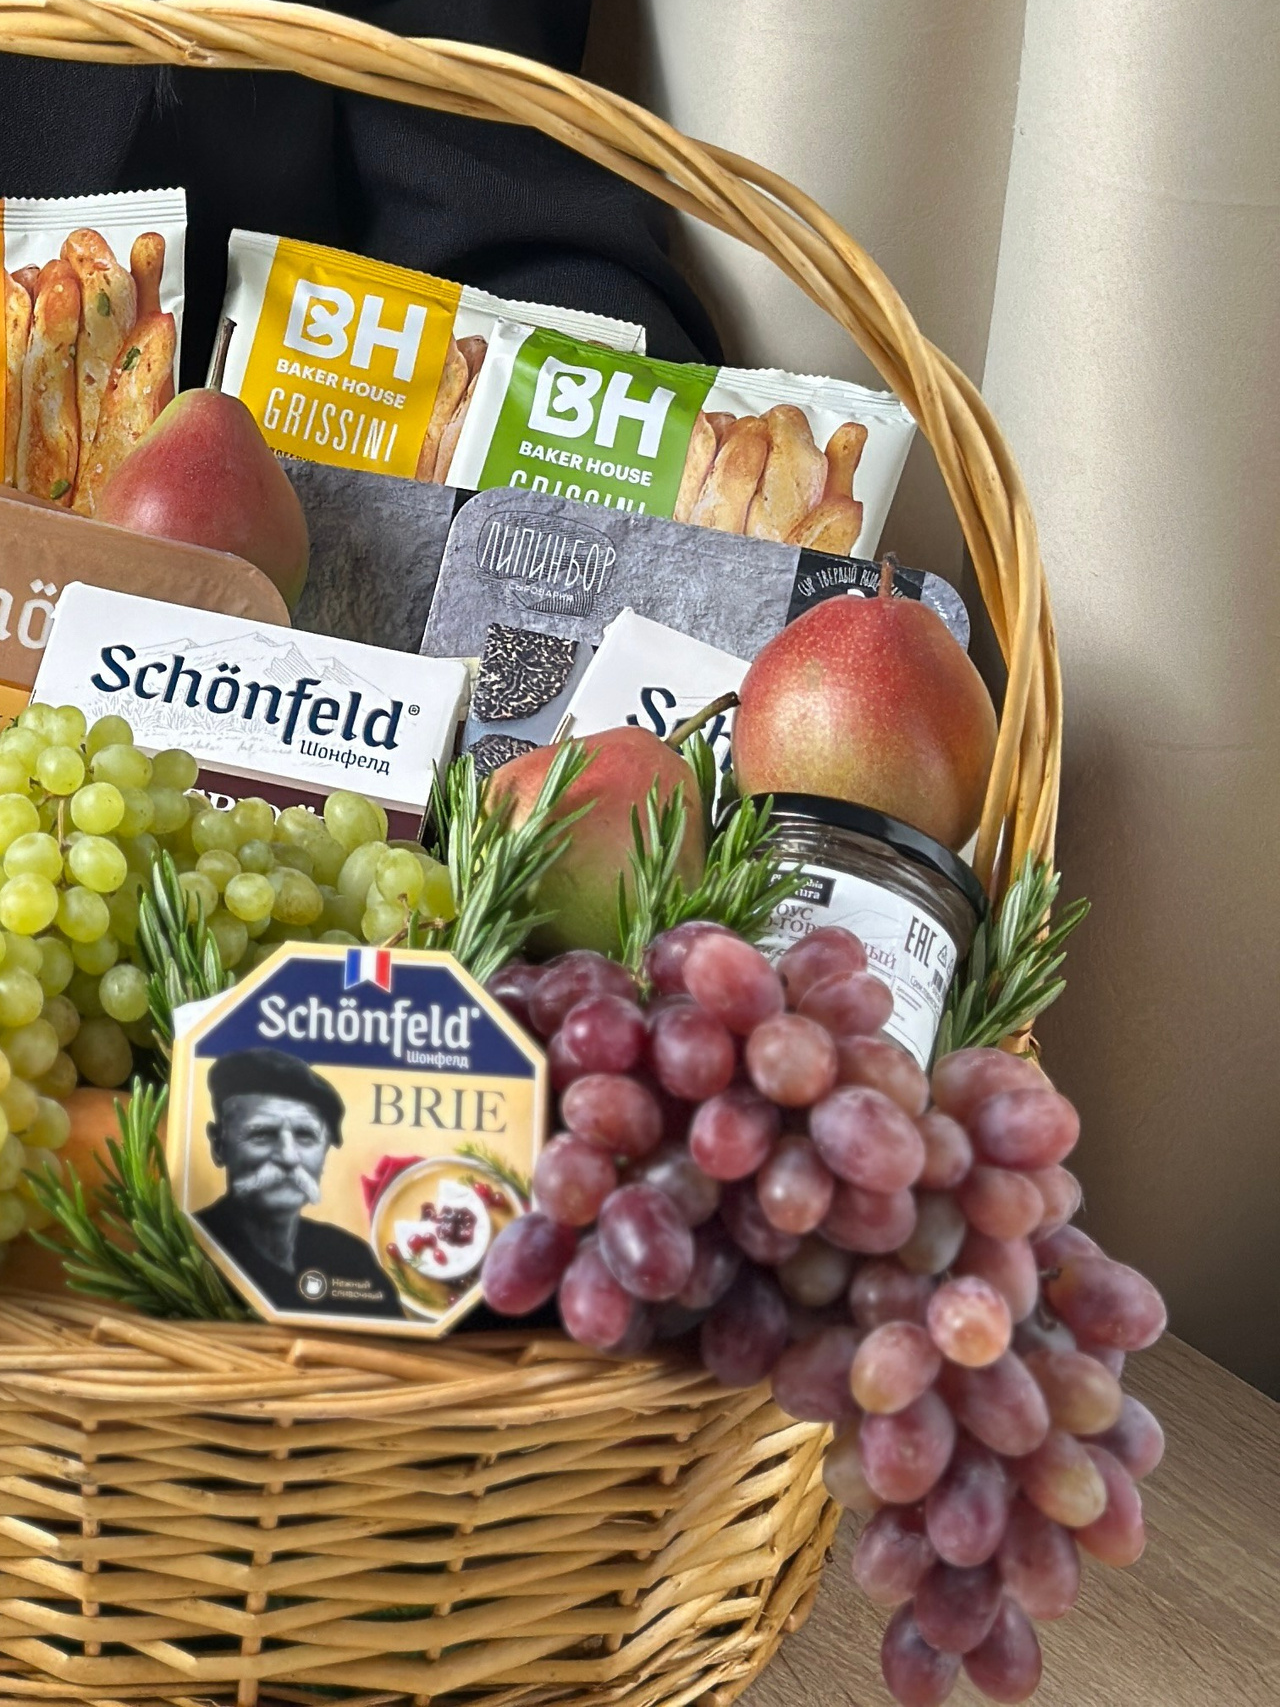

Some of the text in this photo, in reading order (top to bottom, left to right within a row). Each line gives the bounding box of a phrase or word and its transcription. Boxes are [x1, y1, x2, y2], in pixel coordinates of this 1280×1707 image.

[283, 278, 428, 383] BH
[276, 358, 407, 410] BAKER HOUSE
[527, 355, 677, 459] BH
[263, 387, 399, 462] GRISSINI
[519, 440, 653, 488] BAKER HOUSE
[91, 644, 404, 750] Schönfeld
[299, 740, 391, 776] Шонфелд
[258, 994, 472, 1058] Schönfeld
[406, 1049, 470, 1070] Шонфелд
[370, 1083, 508, 1134] BRIE
